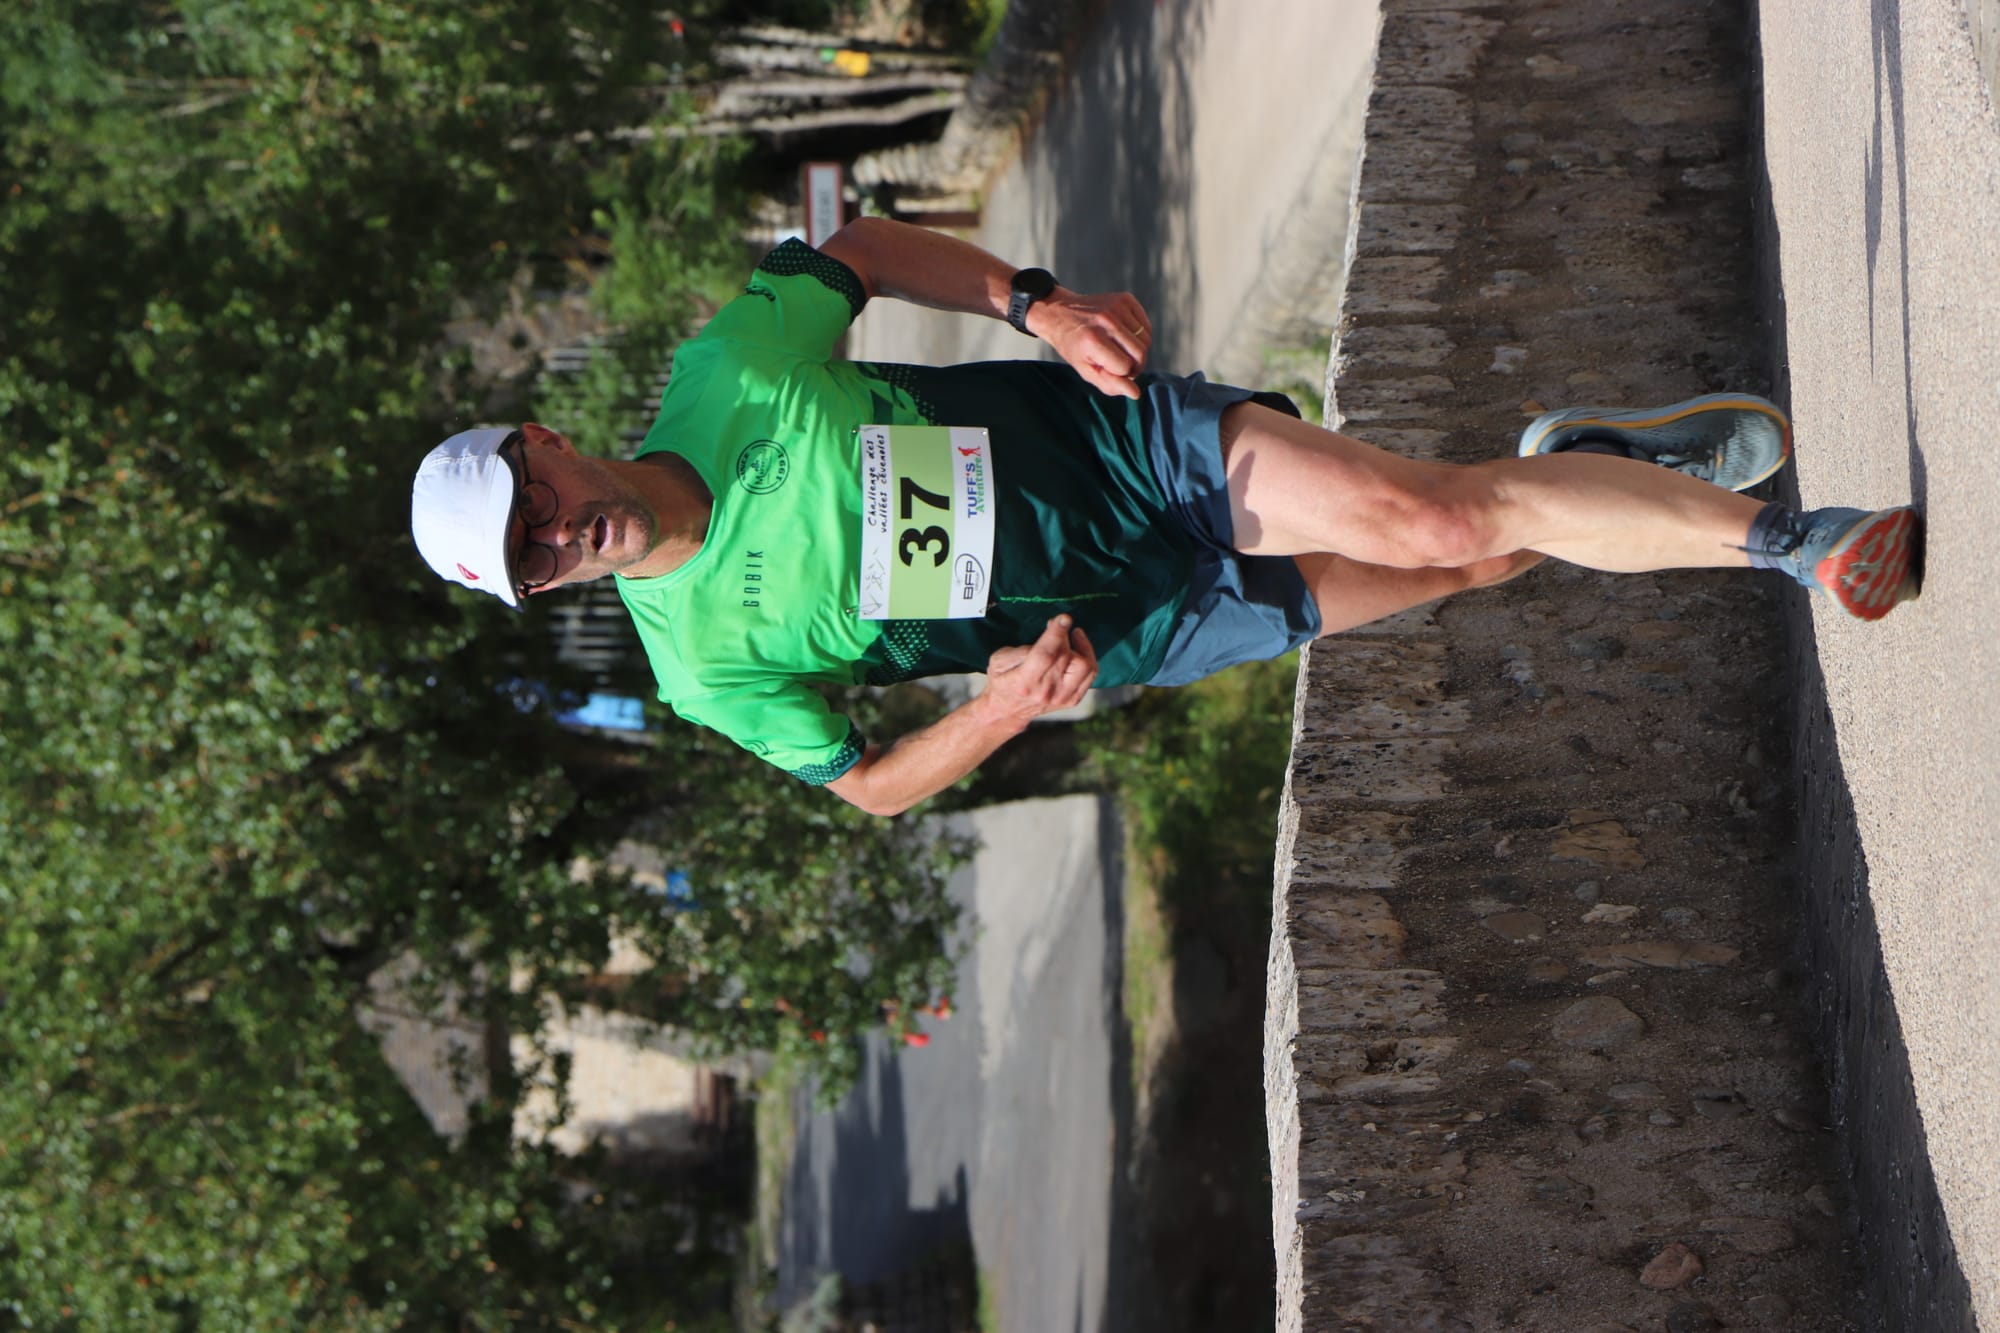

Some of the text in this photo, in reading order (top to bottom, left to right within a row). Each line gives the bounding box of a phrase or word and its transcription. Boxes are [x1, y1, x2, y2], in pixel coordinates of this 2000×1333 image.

[775, 453, 786, 482] 1991
[866, 439, 881, 527] Challenge des
[876, 434, 888, 533] vallées cévenoles
[966, 462, 978, 518] TUFF'S
[975, 457, 984, 512] Aventure
[899, 477, 950, 568] 37
[743, 549, 763, 608] GOBIK
[963, 560, 974, 600] BFP
